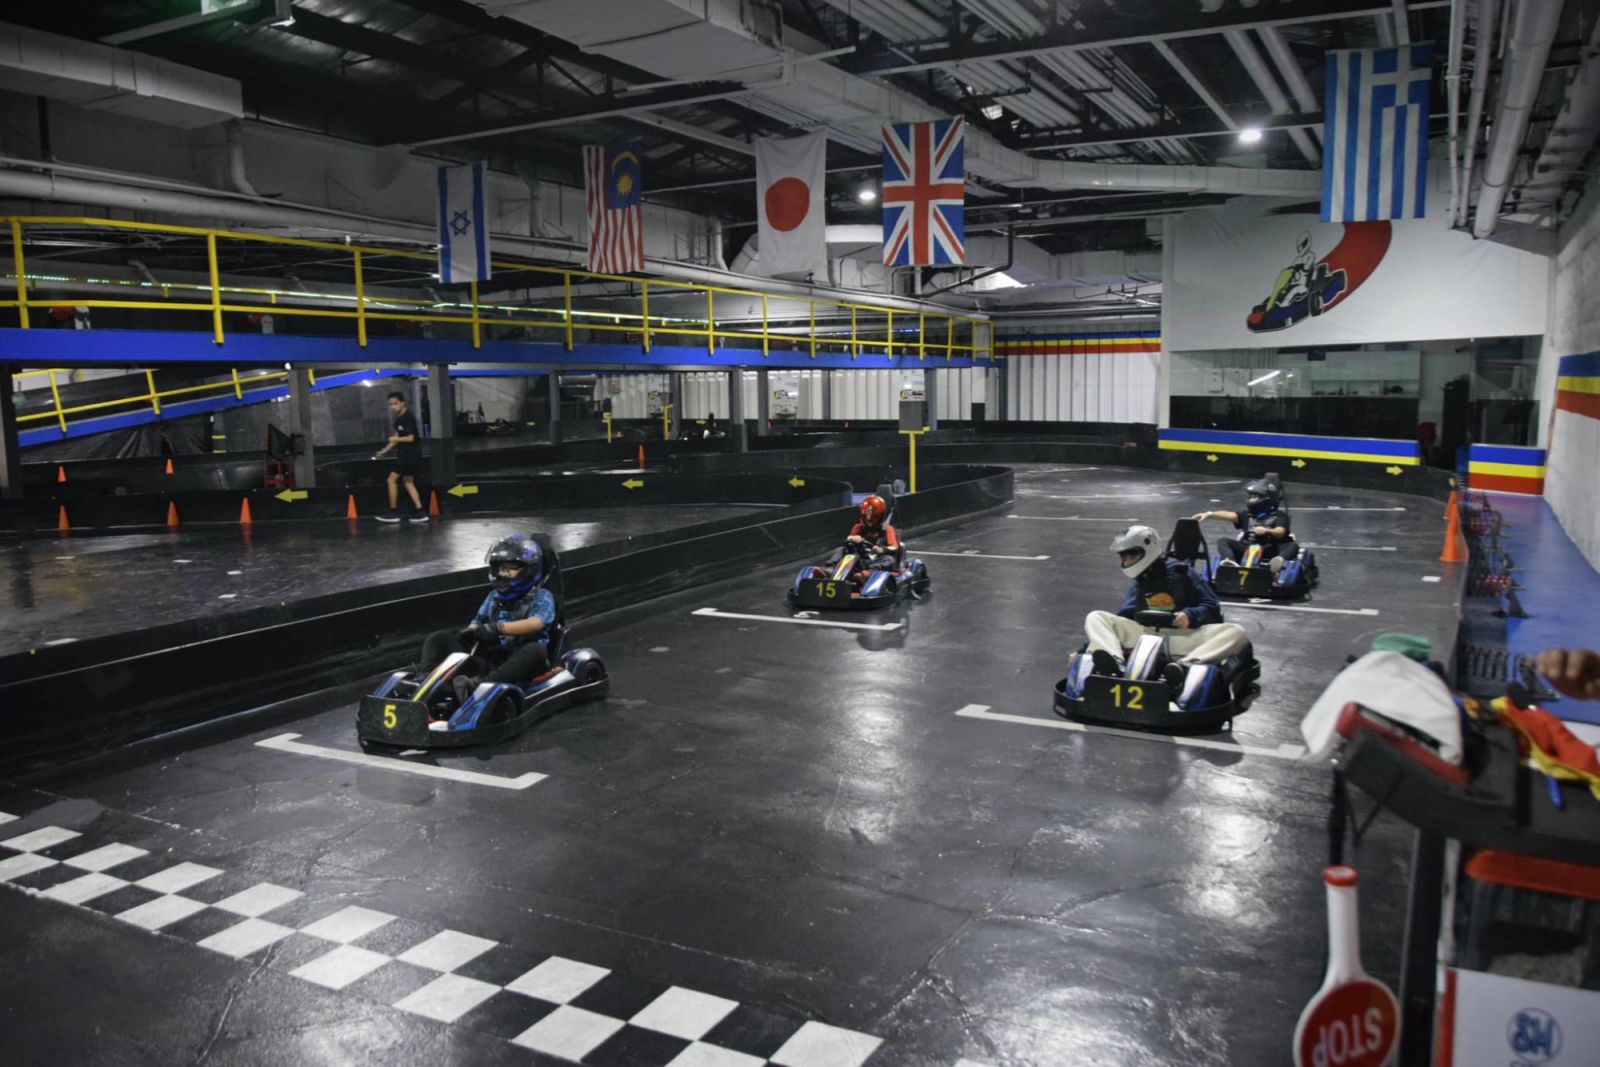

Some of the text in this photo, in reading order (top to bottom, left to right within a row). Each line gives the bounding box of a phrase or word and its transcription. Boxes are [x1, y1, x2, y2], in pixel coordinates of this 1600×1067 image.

[816, 582, 836, 598] 15
[1238, 570, 1249, 586] 7
[1109, 684, 1144, 709] 12
[383, 704, 397, 729] 5
[1311, 1007, 1383, 1067] STOP
